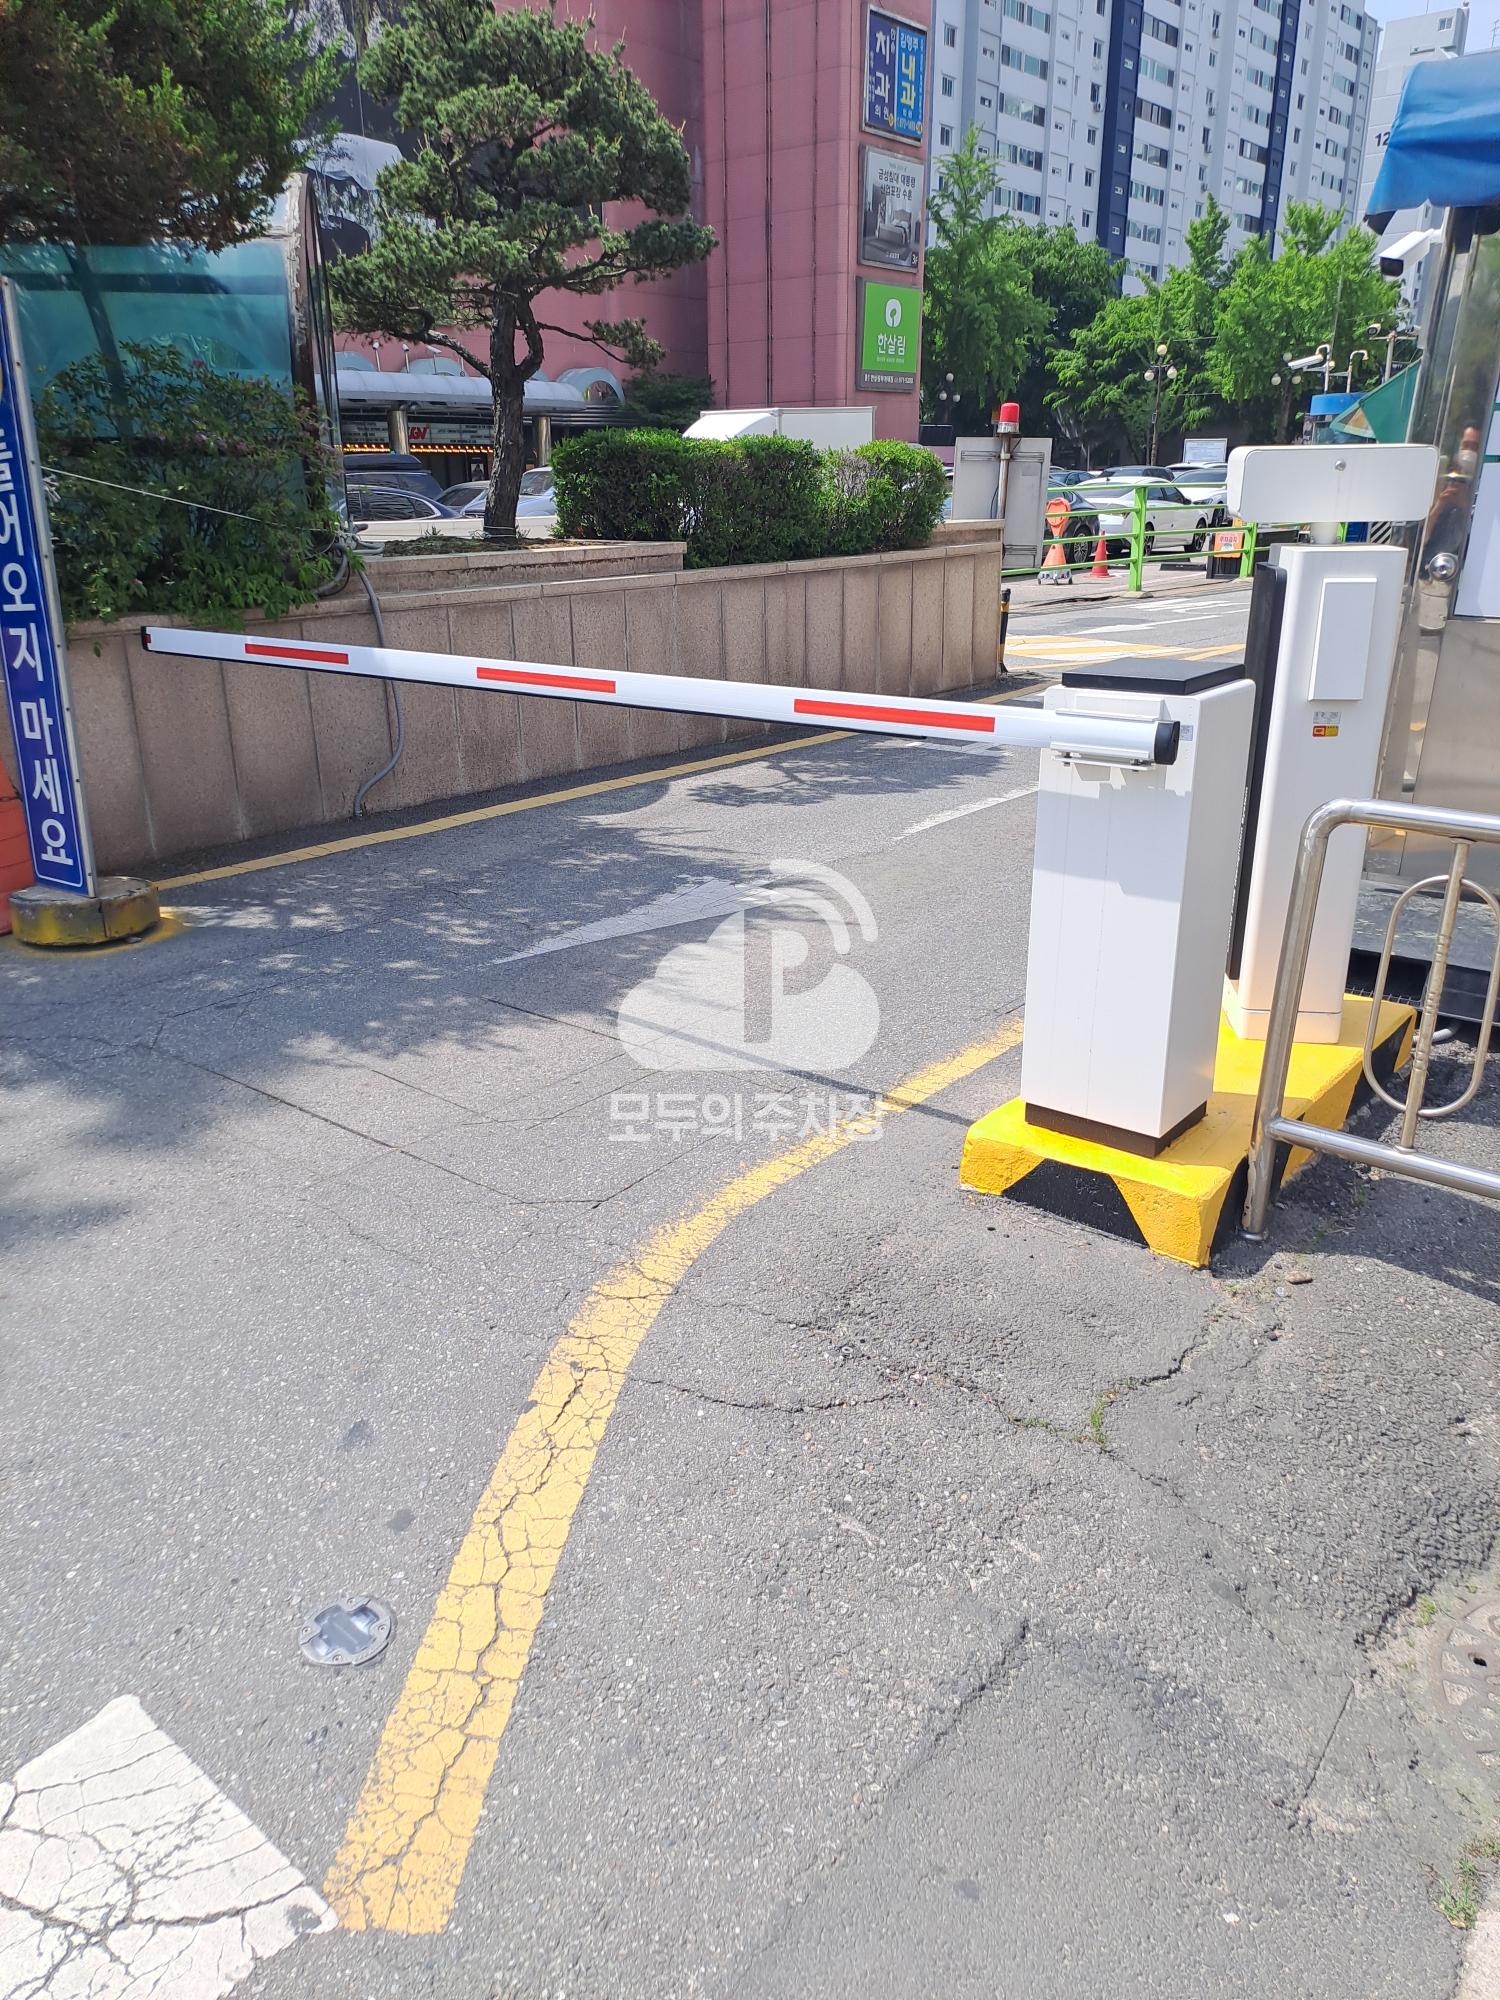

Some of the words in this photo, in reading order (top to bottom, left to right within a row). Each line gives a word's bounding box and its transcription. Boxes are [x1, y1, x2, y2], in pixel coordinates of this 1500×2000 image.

[875, 31, 890, 104] 치과
[901, 53, 916, 110] 내과
[877, 333, 906, 356] 한살림
